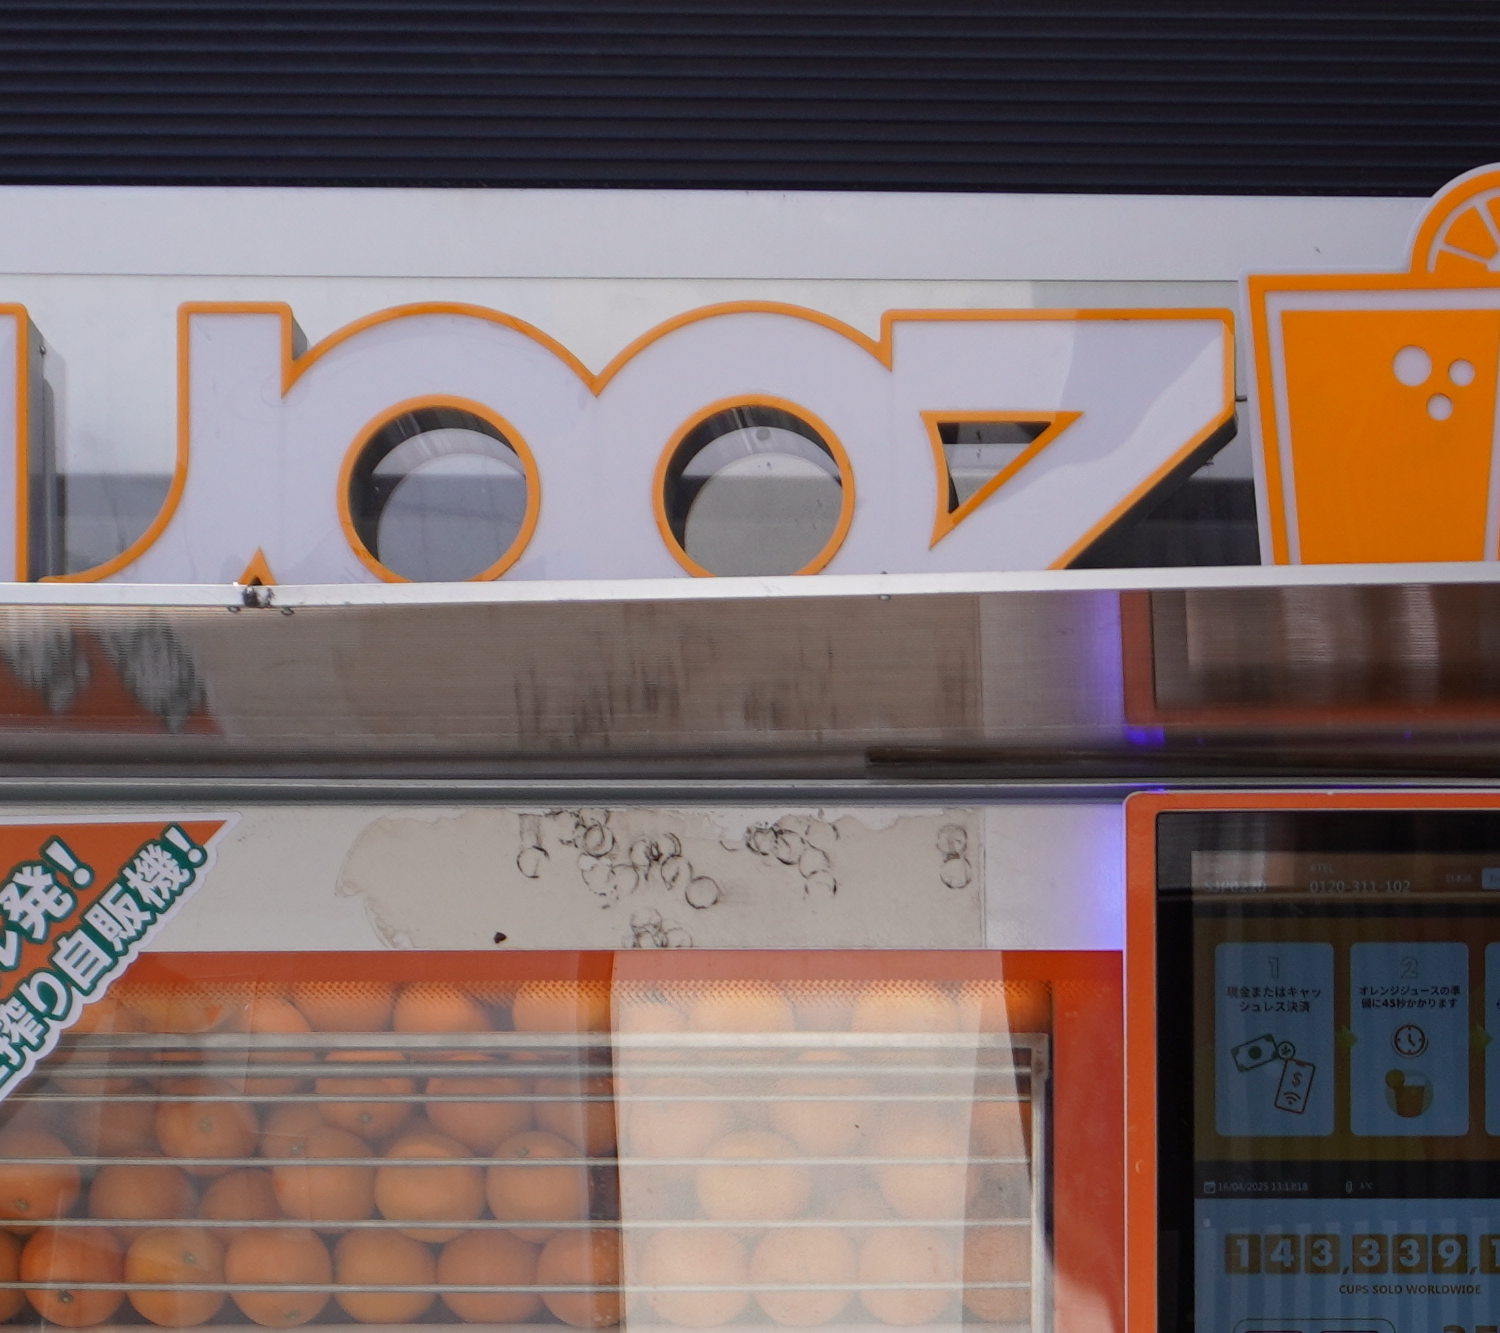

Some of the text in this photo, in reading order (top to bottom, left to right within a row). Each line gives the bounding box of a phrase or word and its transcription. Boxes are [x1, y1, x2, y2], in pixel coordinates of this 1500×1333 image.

[1339, 1285, 1481, 1294] CUPS SOLD WORLDWIDE
